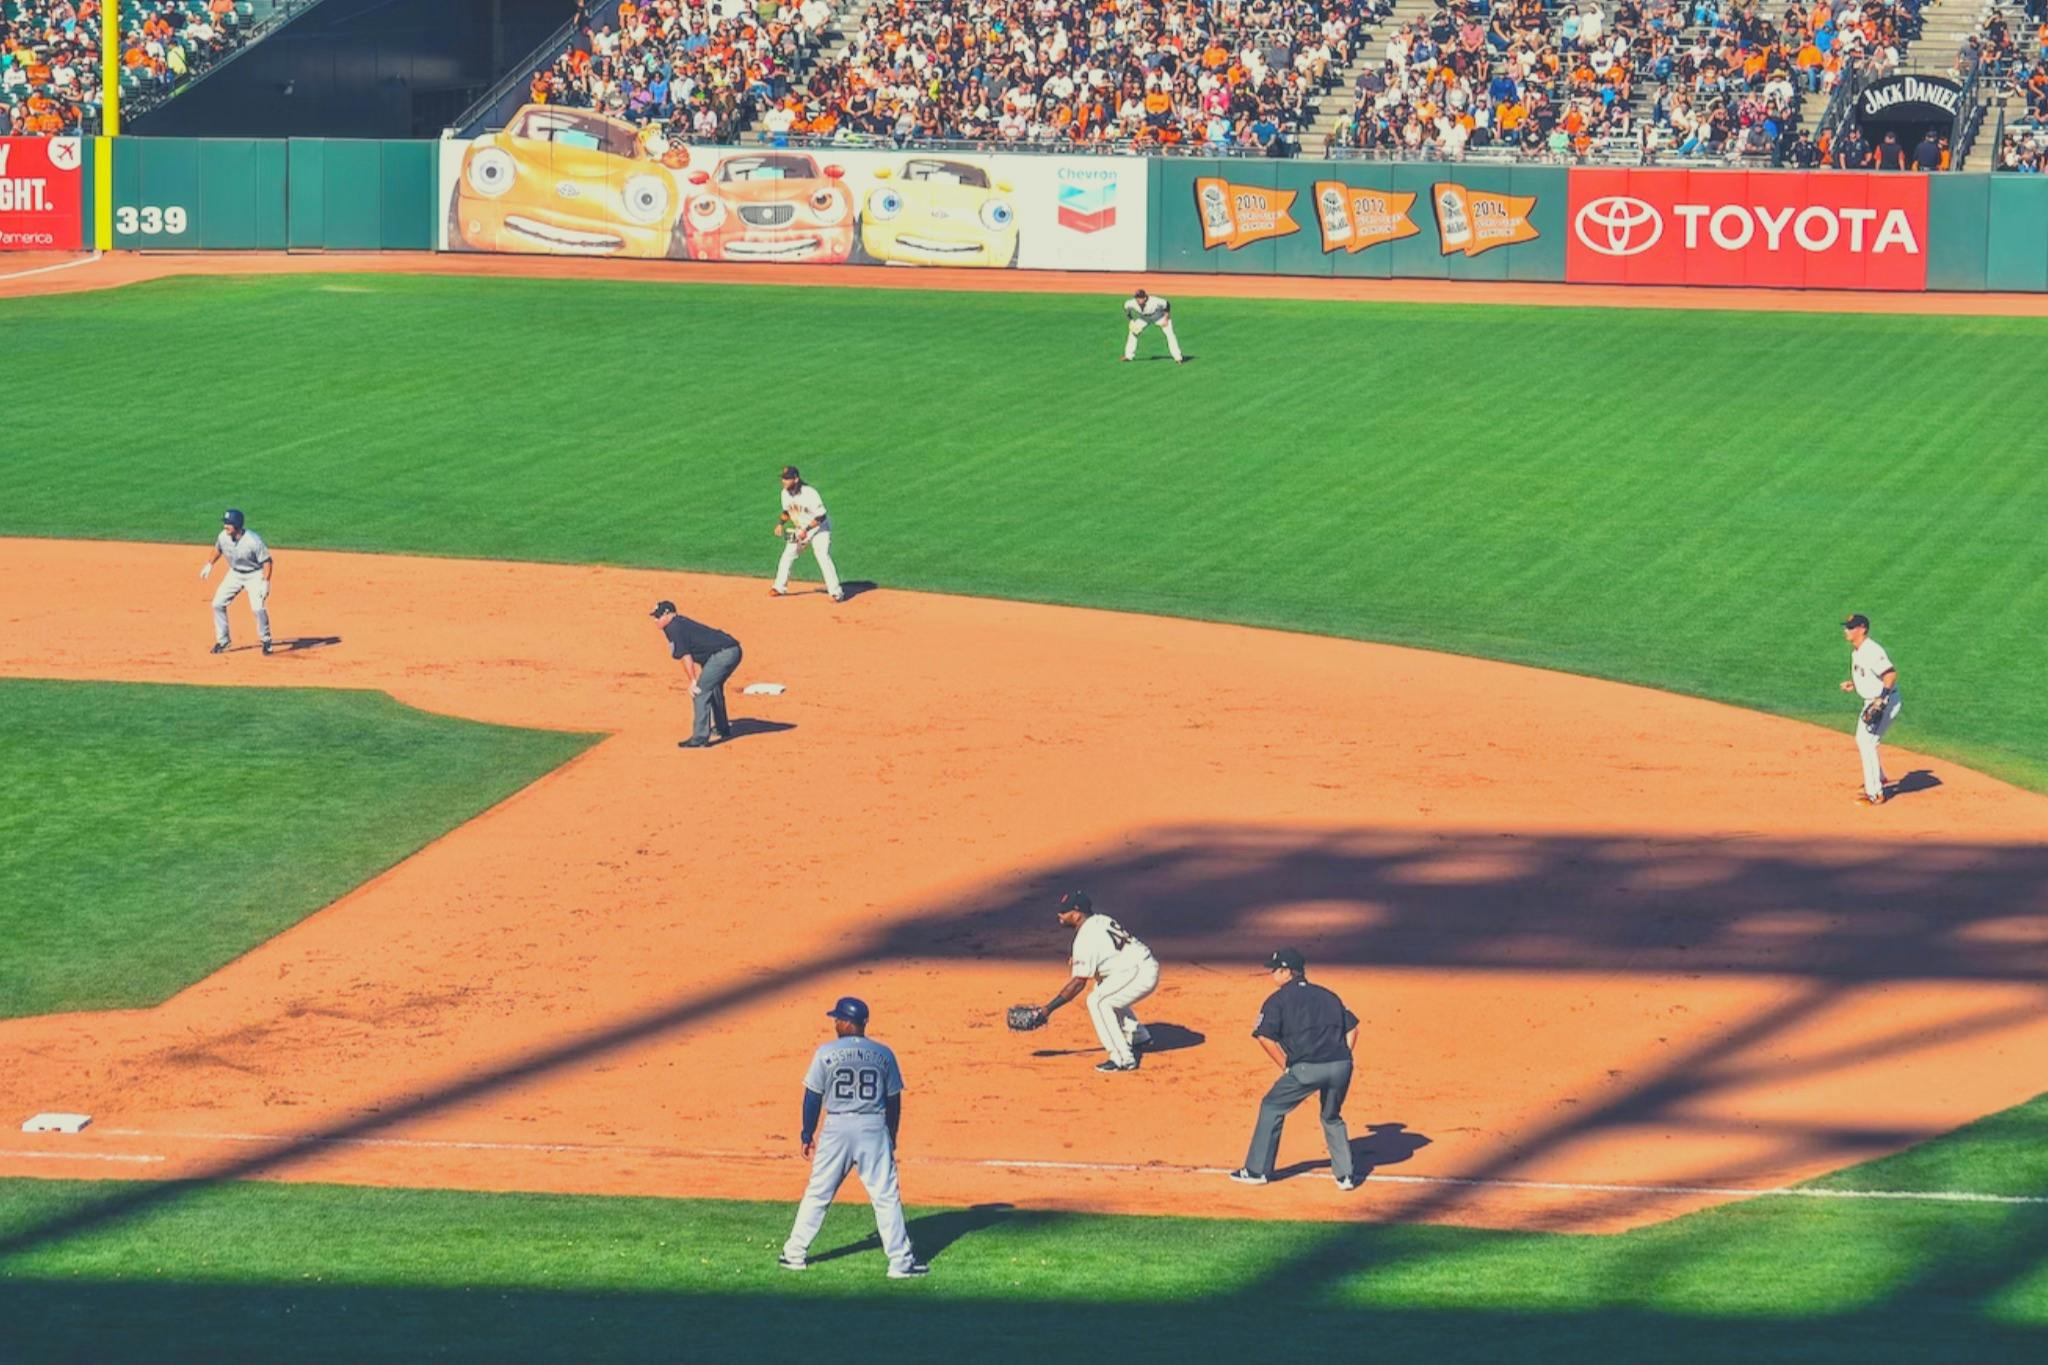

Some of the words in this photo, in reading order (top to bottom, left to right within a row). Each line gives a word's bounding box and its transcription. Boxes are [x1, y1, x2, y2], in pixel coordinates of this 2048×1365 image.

[1864, 83, 1904, 114] JACK
[1057, 167, 1117, 180] Chevron
[1236, 194, 1266, 211] 2010
[1354, 198, 1384, 215] 2012
[1473, 200, 1506, 218] 2014
[116, 206, 187, 235] 339
[1673, 204, 1919, 254] TOYOTA
[834, 1067, 878, 1101] 28
